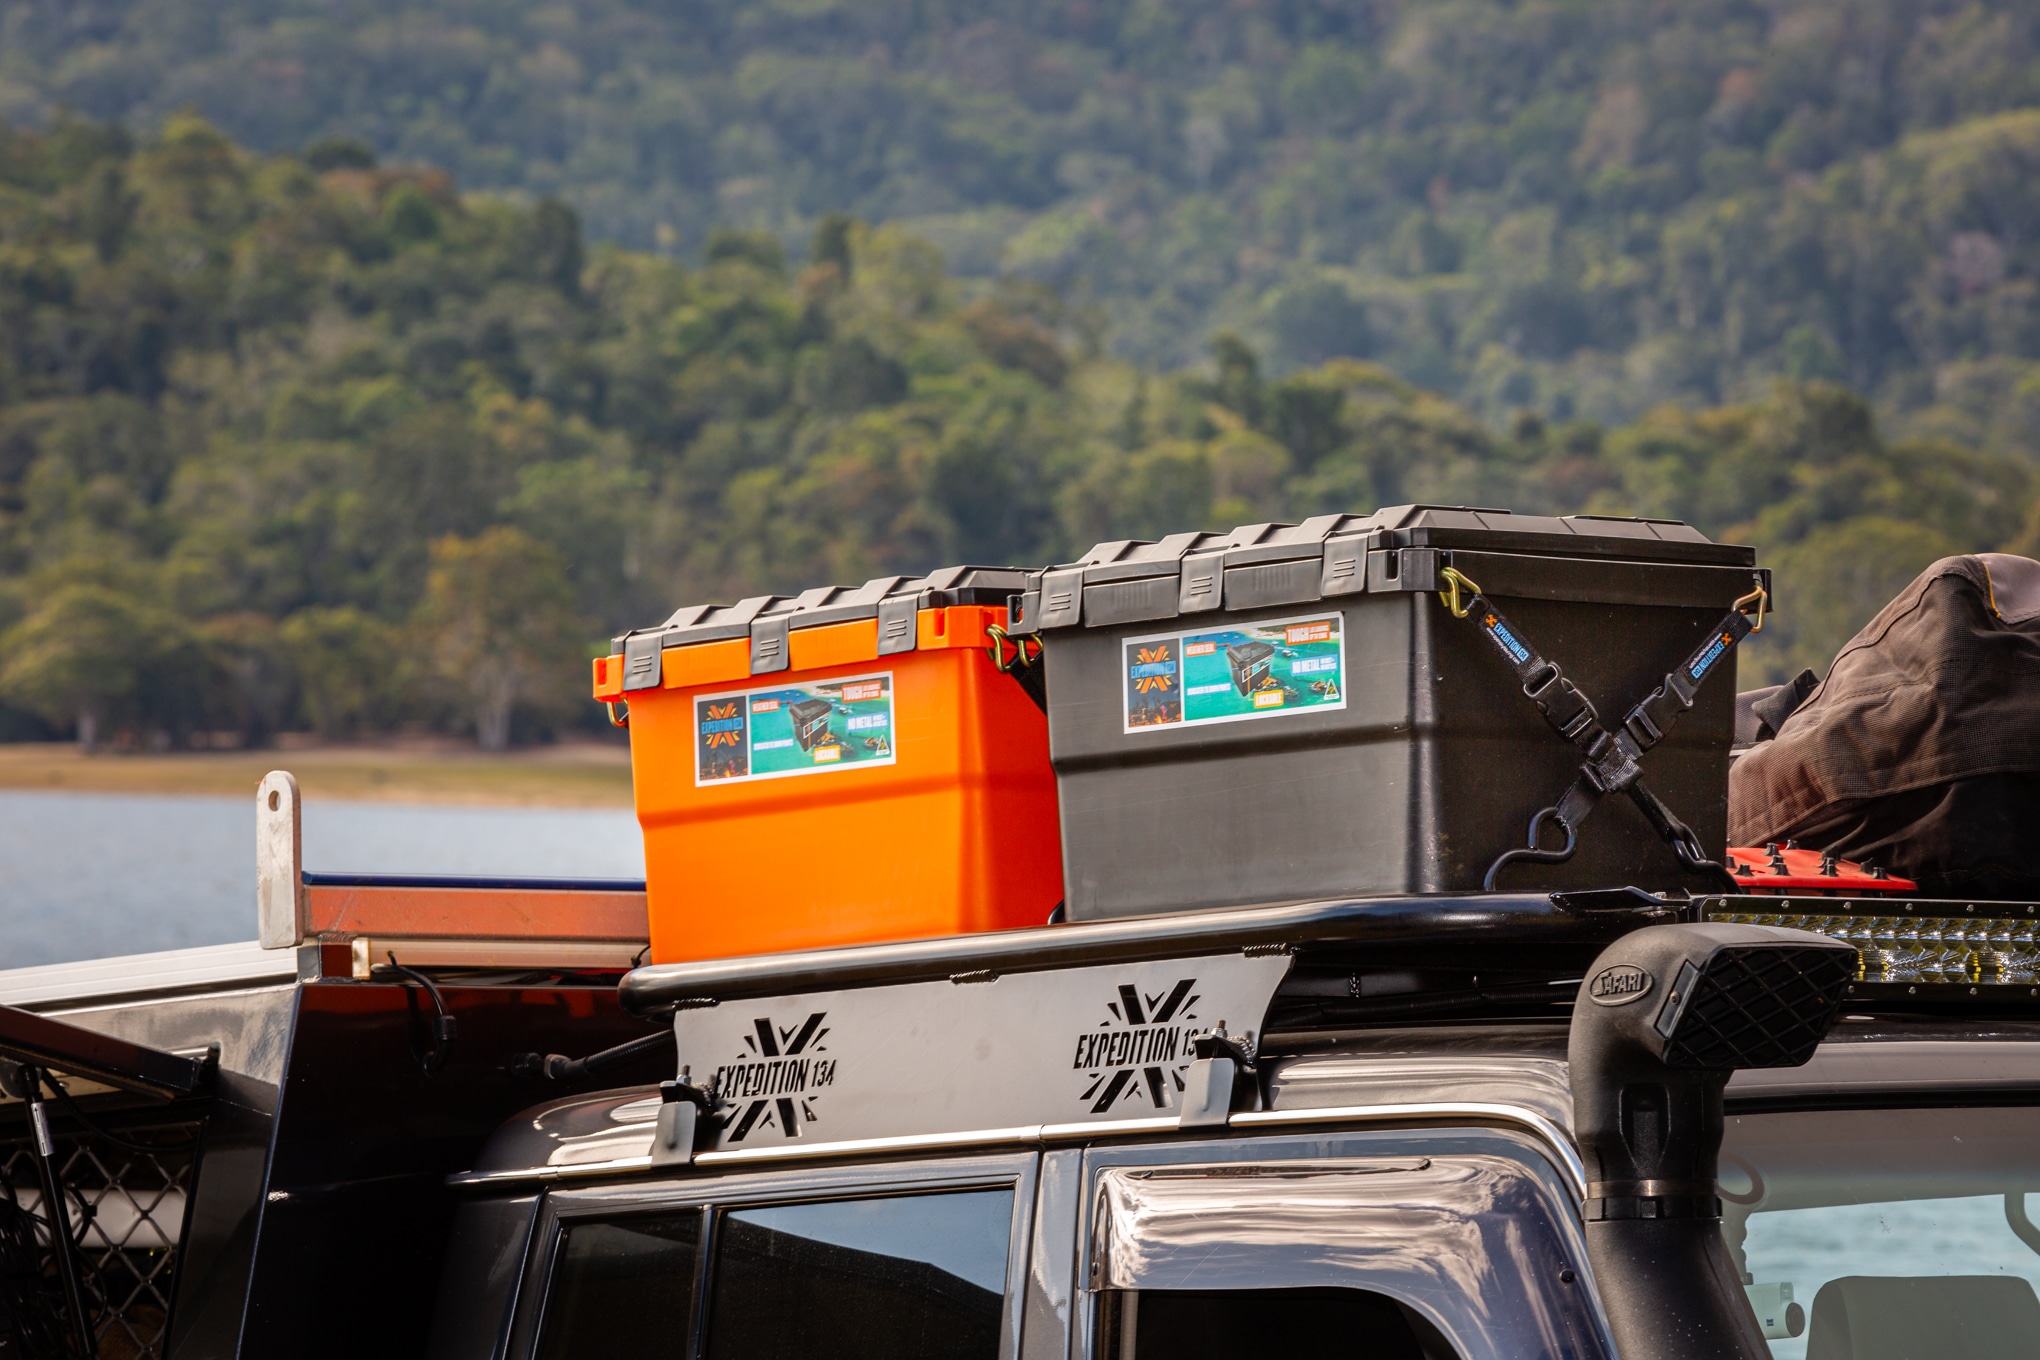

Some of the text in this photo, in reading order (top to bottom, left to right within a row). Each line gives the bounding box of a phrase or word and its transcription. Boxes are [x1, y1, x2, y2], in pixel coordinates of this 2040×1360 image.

[1493, 622, 1521, 654] EXPEDITION
[1699, 640, 1725, 671] EXPEDITION
[701, 718, 734, 735] EXPEDITION
[1593, 972, 1645, 997] SAFARI
[1073, 1027, 1180, 1069] EXPEDITION
[716, 1058, 837, 1099] EXPEDITION 134
